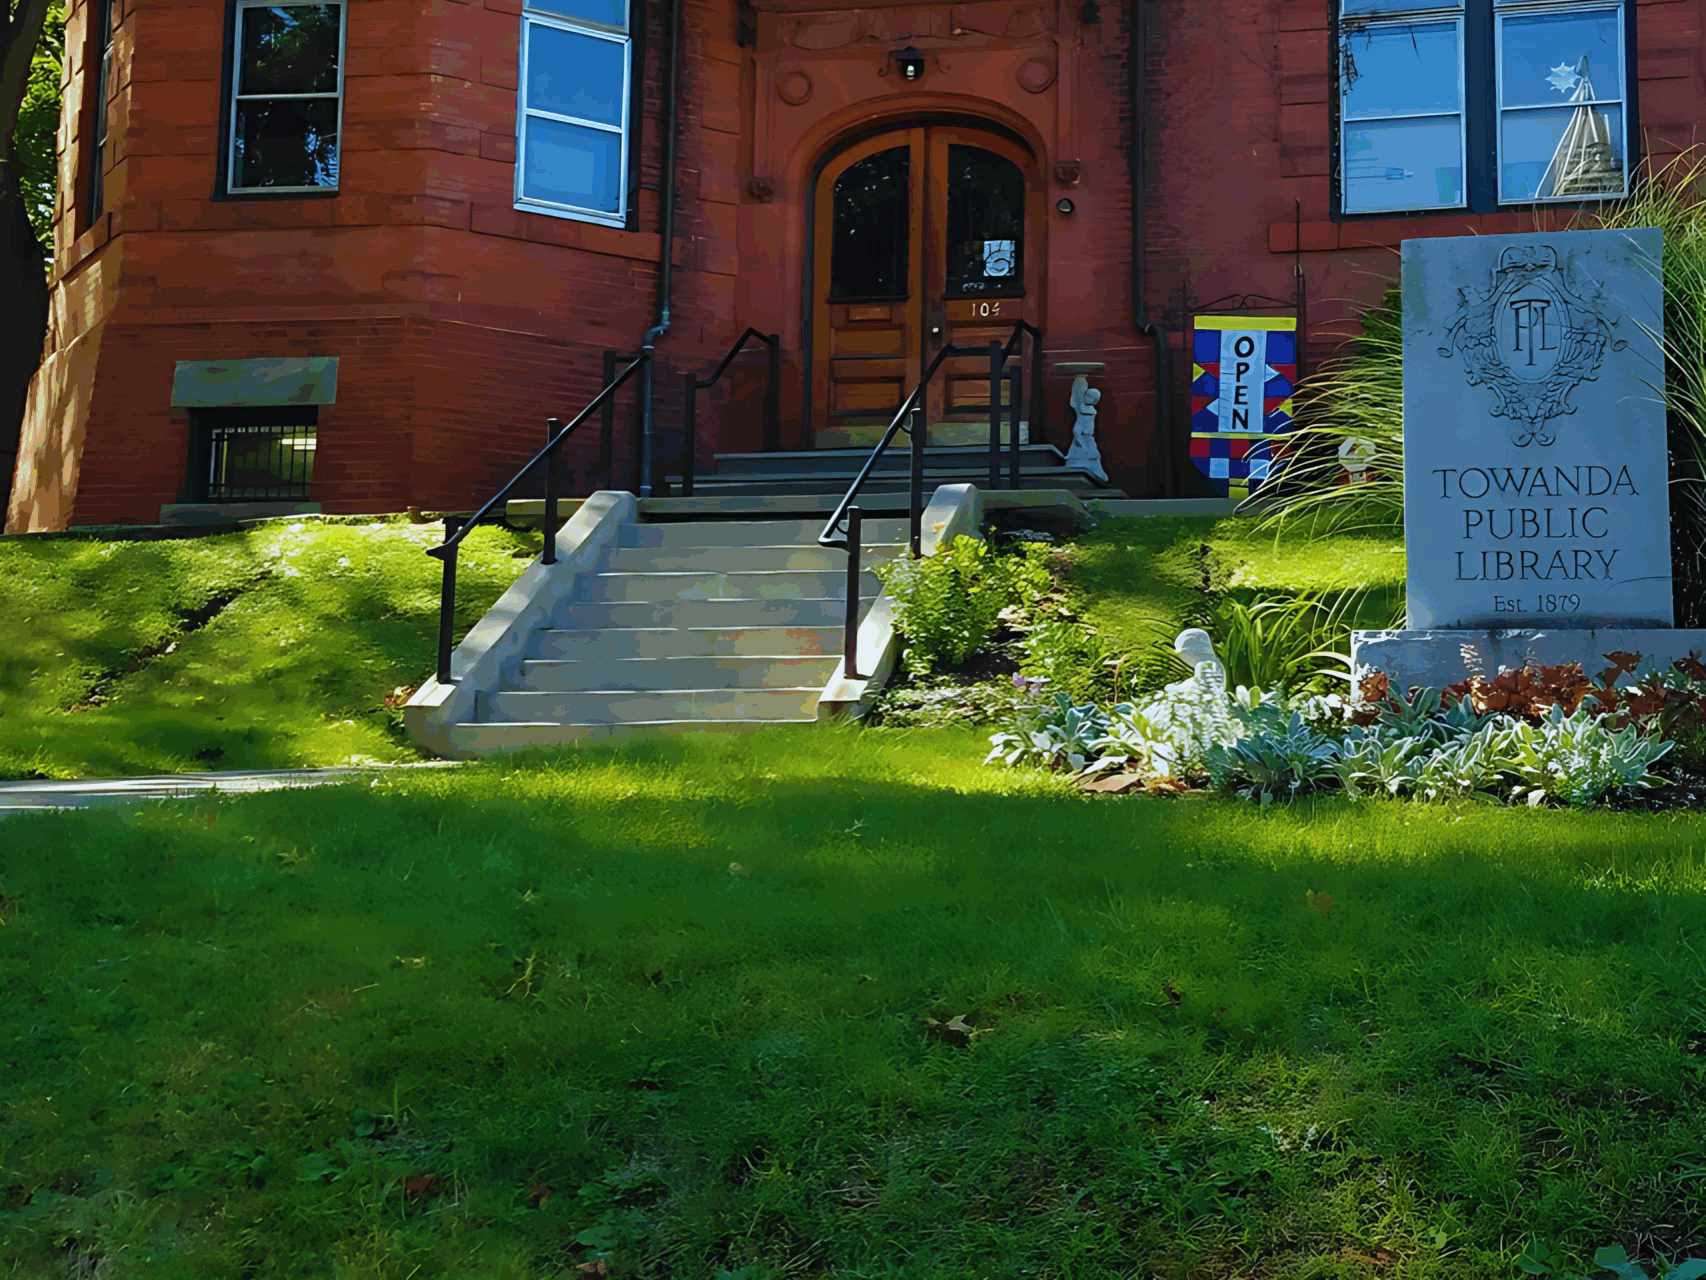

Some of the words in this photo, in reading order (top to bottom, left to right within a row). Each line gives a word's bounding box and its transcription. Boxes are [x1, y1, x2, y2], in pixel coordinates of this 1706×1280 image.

[1231, 335, 1255, 430] OPEN
[1431, 464, 1640, 499] TOWANDA
[1462, 506, 1609, 540] PUBLIC
[1454, 549, 1620, 582] LIBRARY
[1536, 593, 1581, 613] 1879
